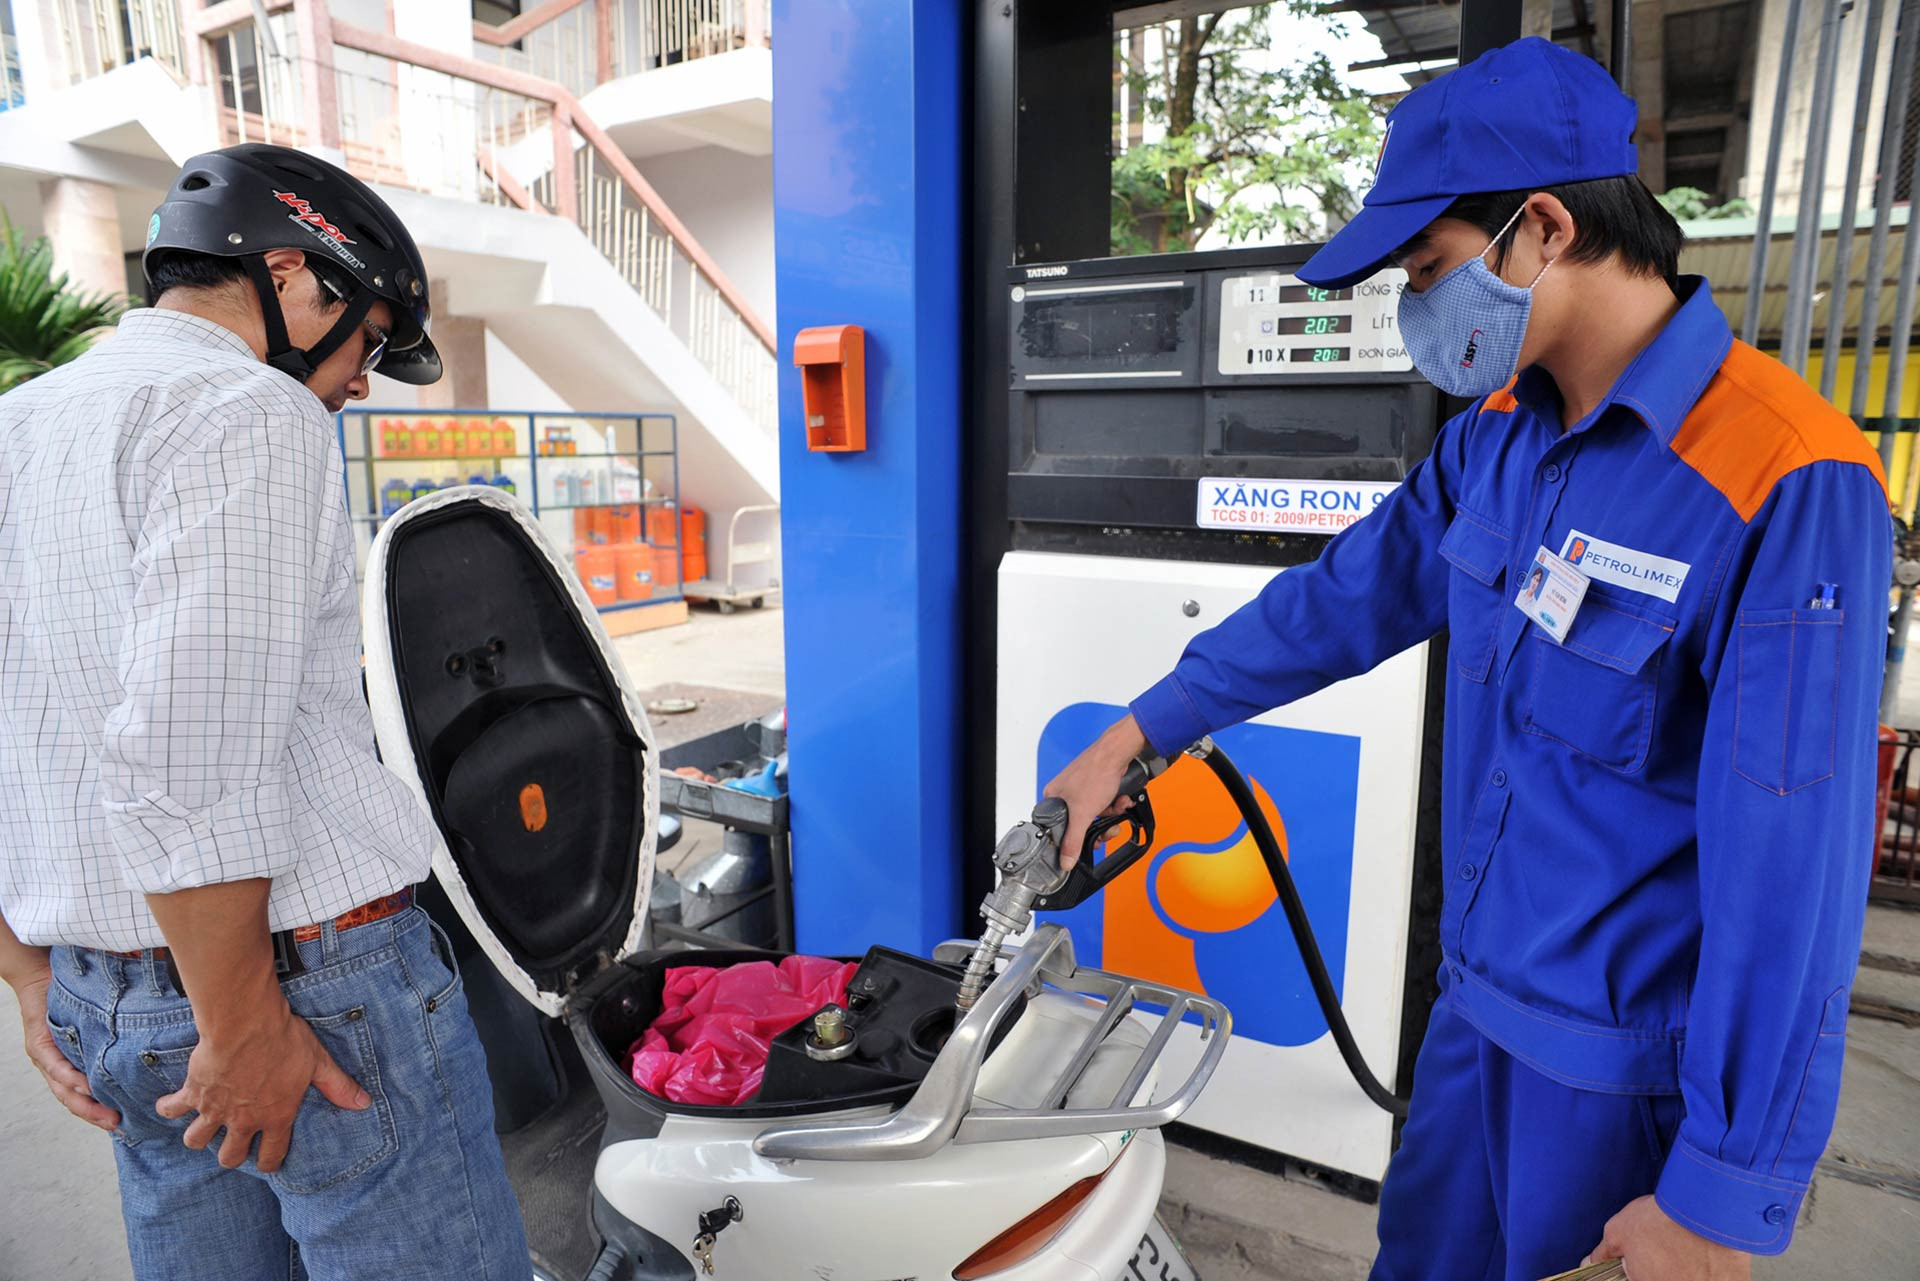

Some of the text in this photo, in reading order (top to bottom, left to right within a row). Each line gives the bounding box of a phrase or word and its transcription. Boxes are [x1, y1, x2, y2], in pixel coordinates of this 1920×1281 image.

[1026, 266, 1068, 278] TATSUNO
[1372, 313, 1395, 329] LÍT
[1258, 347, 1286, 362] 10 X
[1313, 349, 1340, 362] 208
[1213, 483, 1290, 509] XĂNG
[1300, 489, 1361, 512] RON
[1211, 508, 1362, 527] TCCS 01: 2009/PETRO
[1584, 551, 1683, 589] PETROLIMEX
